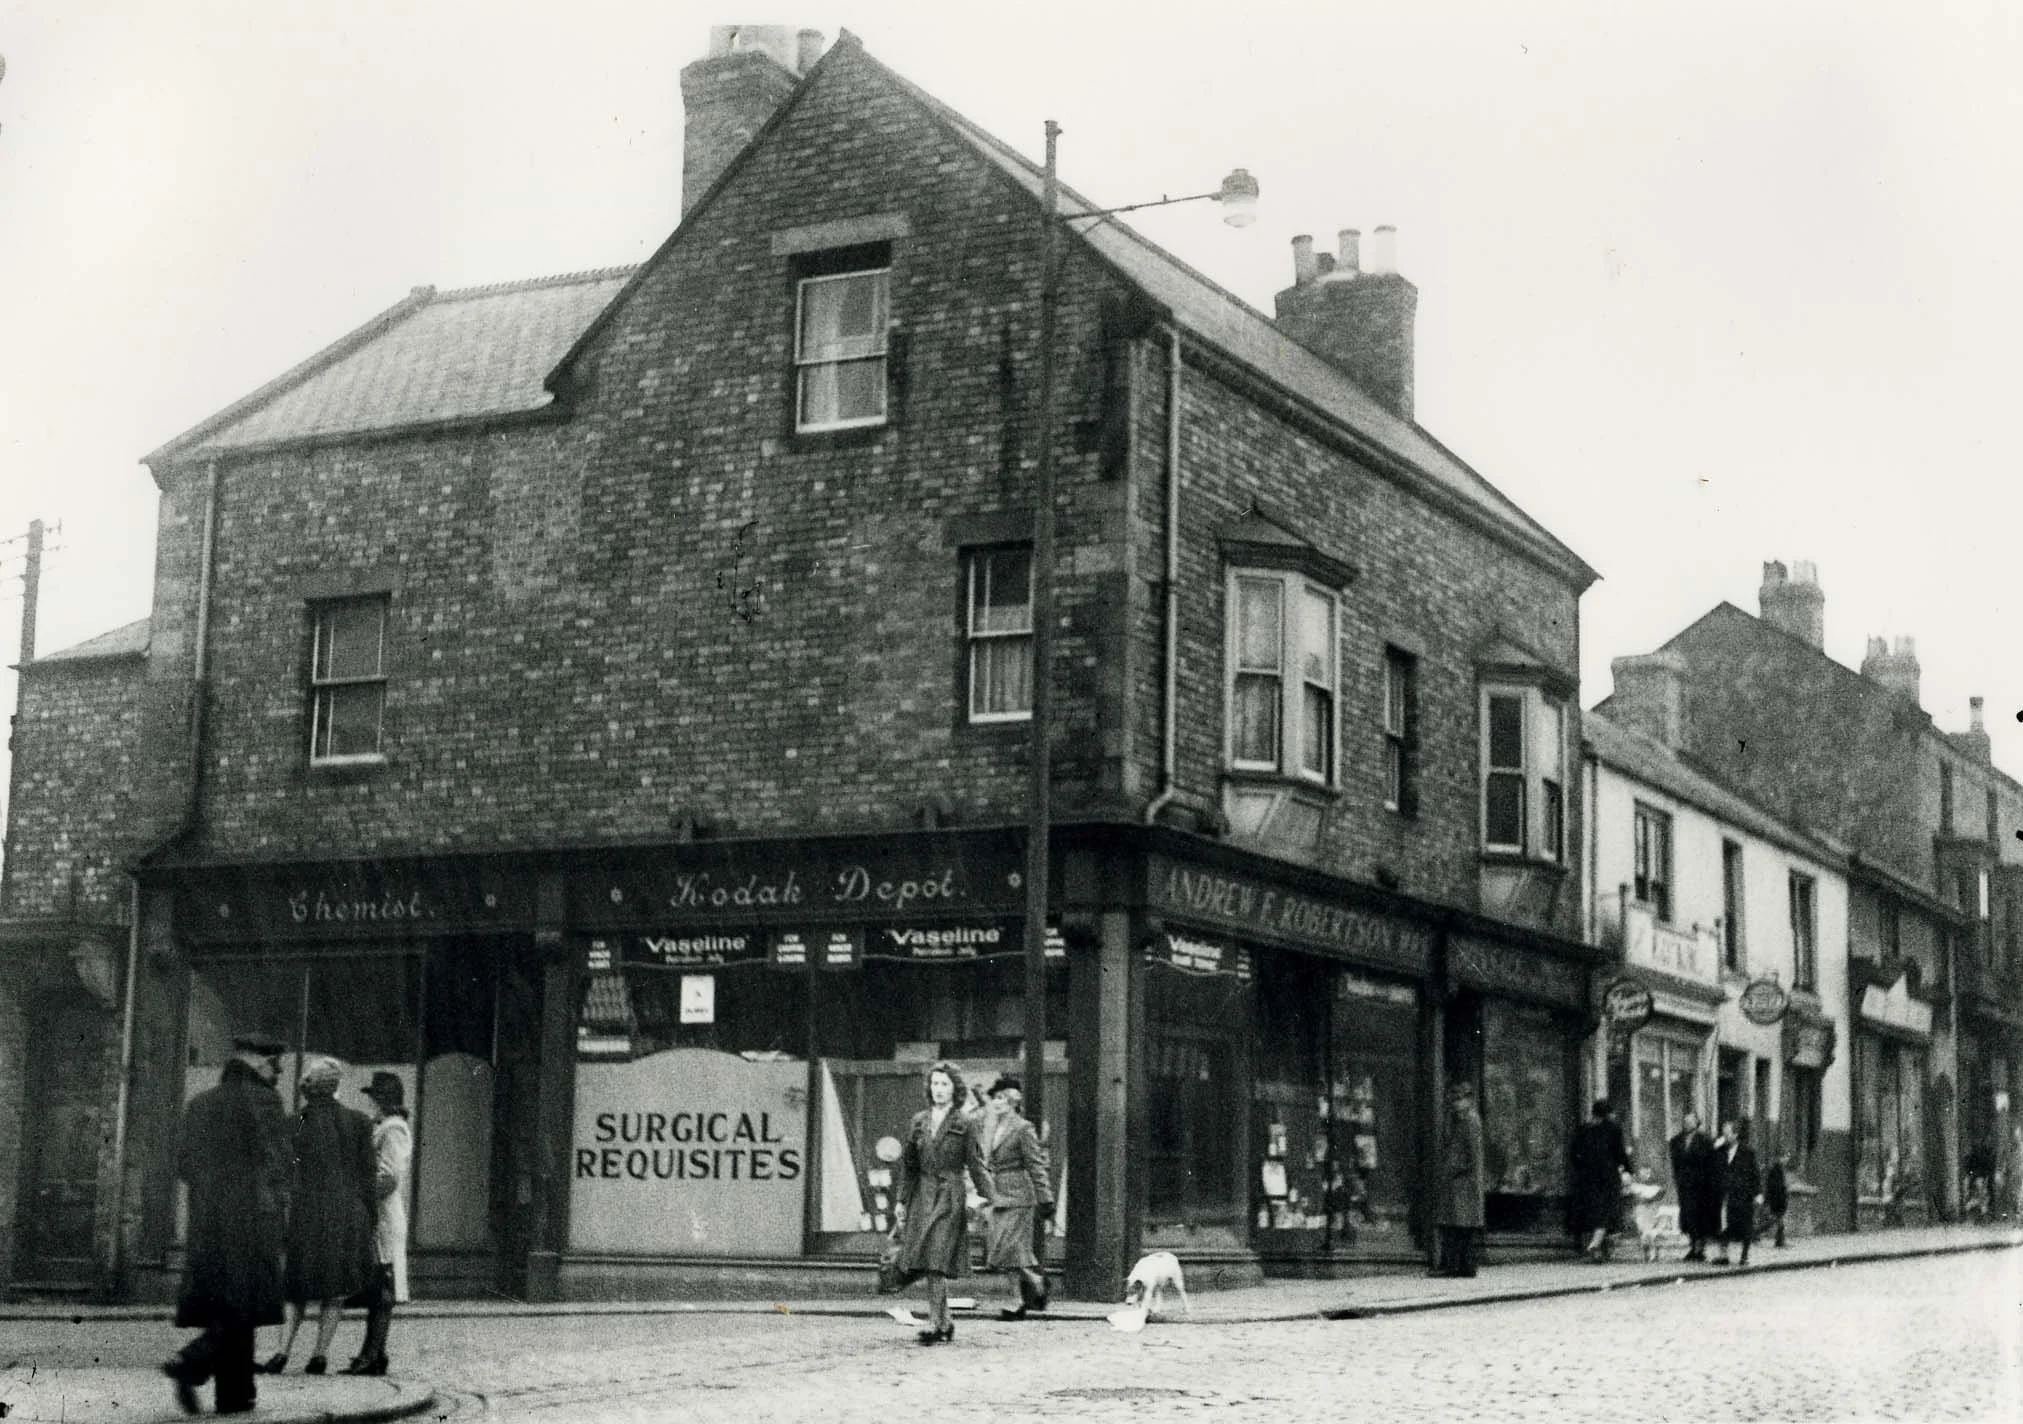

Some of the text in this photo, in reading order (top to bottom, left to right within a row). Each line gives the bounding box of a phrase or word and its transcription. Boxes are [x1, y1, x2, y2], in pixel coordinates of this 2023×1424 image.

[670, 870, 805, 907] Kodak
[1167, 867, 1254, 918] ANDREW
[595, 1112, 781, 1144] SURGICAL
[575, 1148, 802, 1180] REQUISITES
